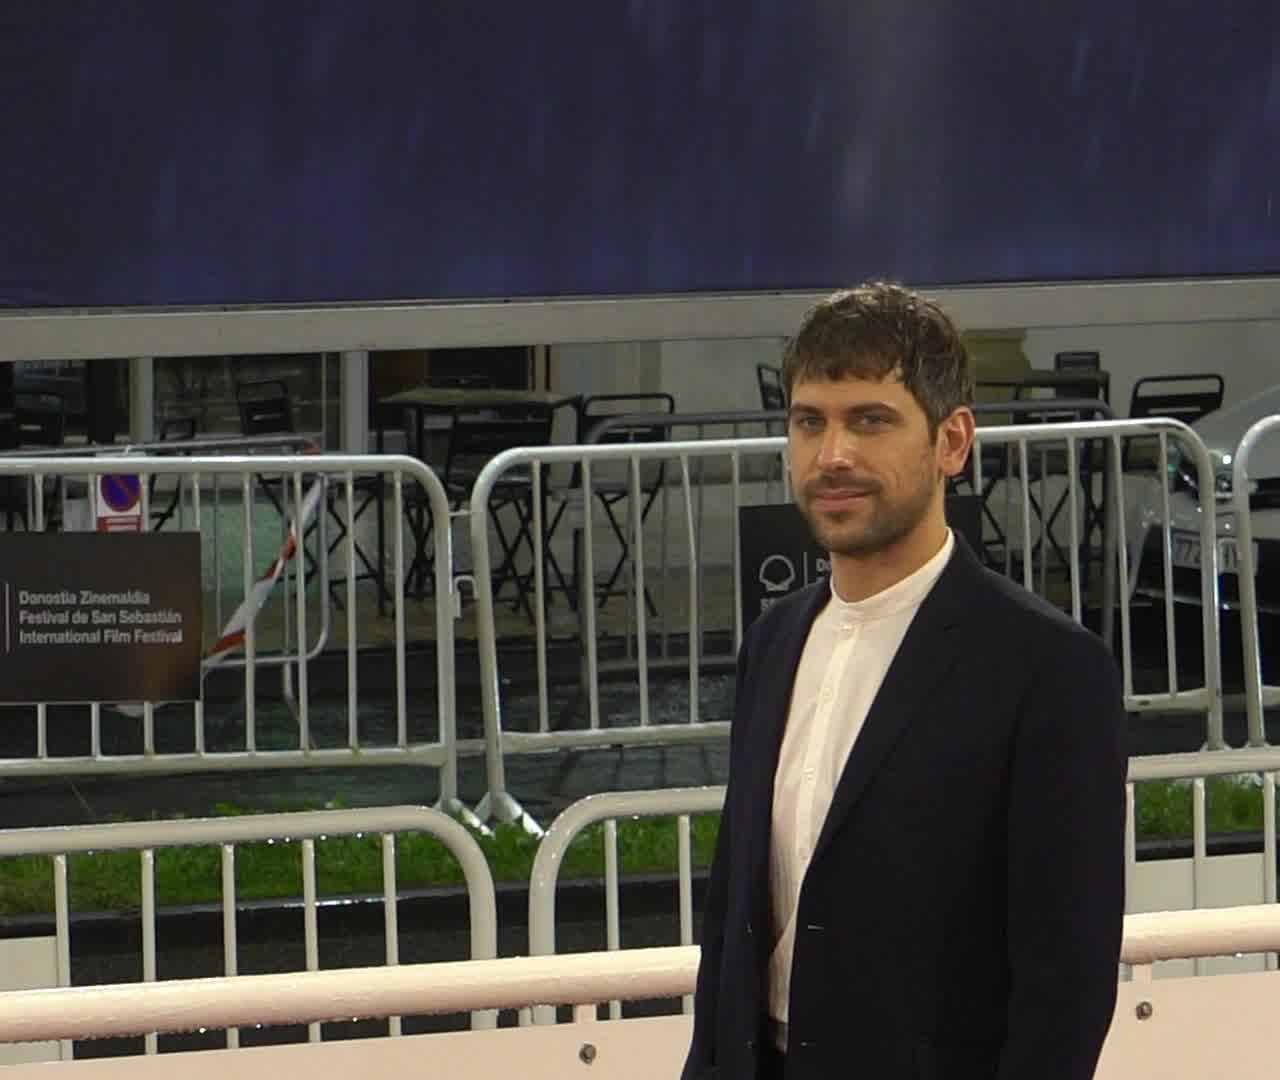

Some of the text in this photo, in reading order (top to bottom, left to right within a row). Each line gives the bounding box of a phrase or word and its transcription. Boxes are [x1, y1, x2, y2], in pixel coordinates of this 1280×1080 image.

[19, 588, 150, 606] Donostia Zinemaldia
[19, 607, 183, 625] Festival de San Sebastián
[19, 627, 184, 645] International Film Festival
